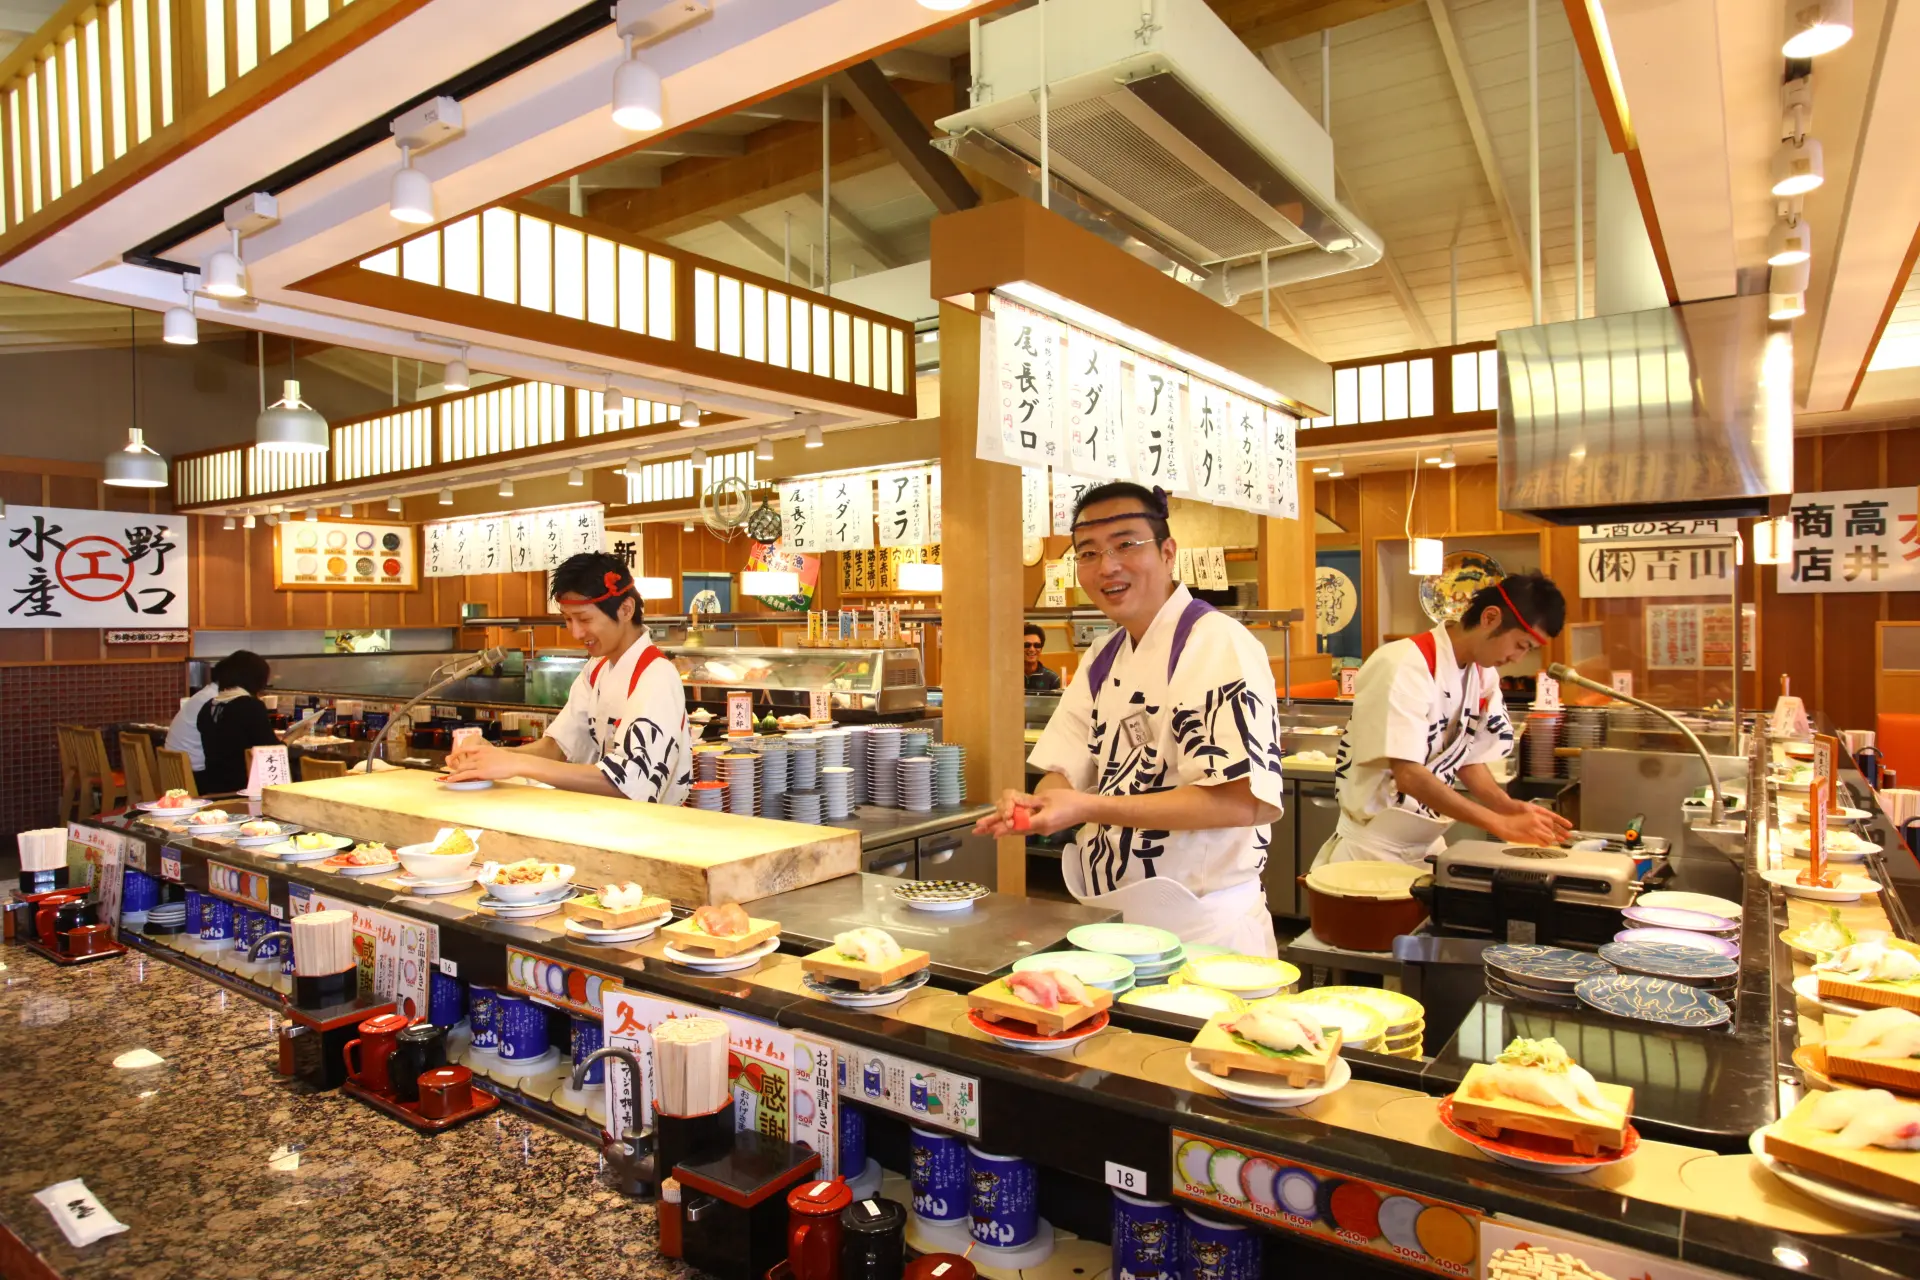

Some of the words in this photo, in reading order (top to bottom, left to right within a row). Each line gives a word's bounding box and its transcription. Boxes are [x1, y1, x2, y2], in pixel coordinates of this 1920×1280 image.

[1014, 326, 1039, 449] 尾長グロ
[1084, 350, 1103, 461] メダイ
[1148, 374, 1164, 476] アラ
[1200, 395, 1213, 487] ホタ
[1241, 411, 1254, 499] 本カツオ
[1274, 427, 1285, 505] 地アジ
[789, 489, 806, 547] 尾長グロ
[836, 482, 851, 542] メダイ
[893, 477, 909, 539] アラ
[458, 527, 466, 569] メダイ
[486, 523, 495, 569] アラ
[516, 526, 525, 566] ホタ
[547, 520, 559, 565] 本カツオ
[614, 540, 637, 568] 新
[1791, 503, 1835, 582] 商店
[1843, 501, 1889, 582] 高井
[8, 515, 67, 618] 水産
[122, 525, 177, 615] 野口
[854, 552, 863, 588] 生うに
[879, 548, 888, 588] 活赤貝
[735, 702, 744, 729] 秋太郎
[418, 931, 426, 990] お品書き
[443, 961, 452, 973] 16
[760, 1073, 786, 1140] 感謝
[816, 1050, 830, 1129] お品書き
[1115, 1169, 1135, 1188] 18
[1185, 1183, 1206, 1196] 90円
[1216, 1192, 1243, 1207] 120円
[1249, 1202, 1277, 1217] 150円
[1283, 1212, 1312, 1228] 180円
[1335, 1228, 1368, 1244] 240円
[1392, 1245, 1427, 1262] 300円
[1434, 1257, 1469, 1275] 400円
